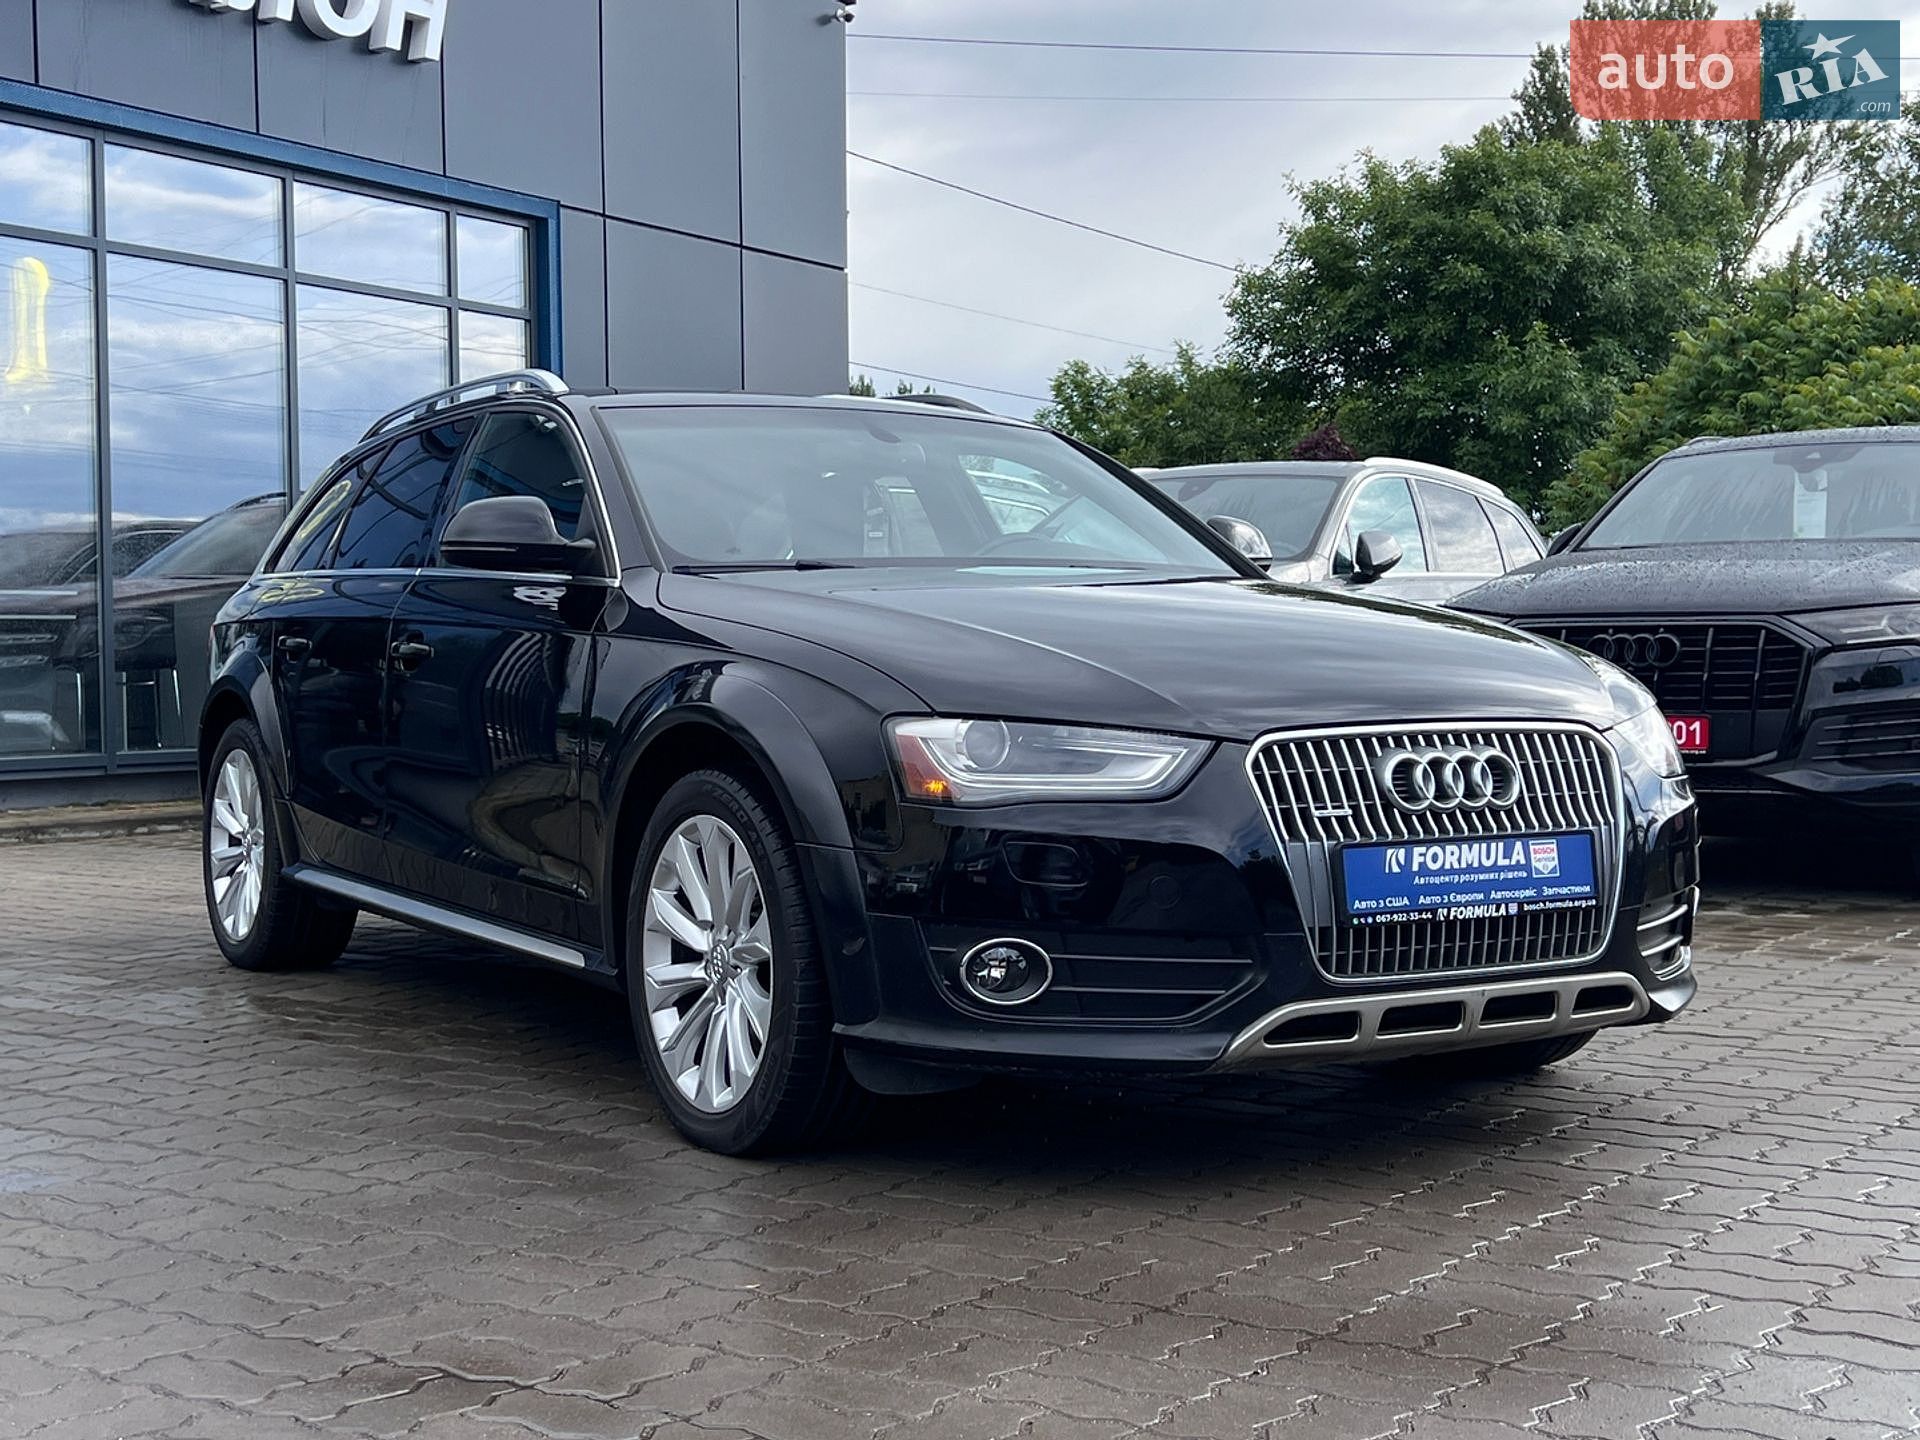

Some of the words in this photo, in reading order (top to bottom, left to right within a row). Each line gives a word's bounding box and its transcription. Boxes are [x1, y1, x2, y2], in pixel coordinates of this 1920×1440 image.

[1668, 720, 1701, 745] 01
[1412, 842, 1526, 872] FORMULA
[1532, 847, 1555, 856] BOSCH
[1413, 874, 1459, 886] Автоцентр
[1460, 871, 1498, 883] розумних
[1500, 869, 1527, 881] рішень
[1490, 887, 1537, 900] Автосервіс
[1541, 885, 1591, 896] Запчастини
[1353, 899, 1377, 910] Авто
[1386, 896, 1410, 907] США
[1418, 894, 1442, 905] Авто
[1449, 891, 1484, 904] Європи
[1449, 903, 1506, 920] FORMULA
